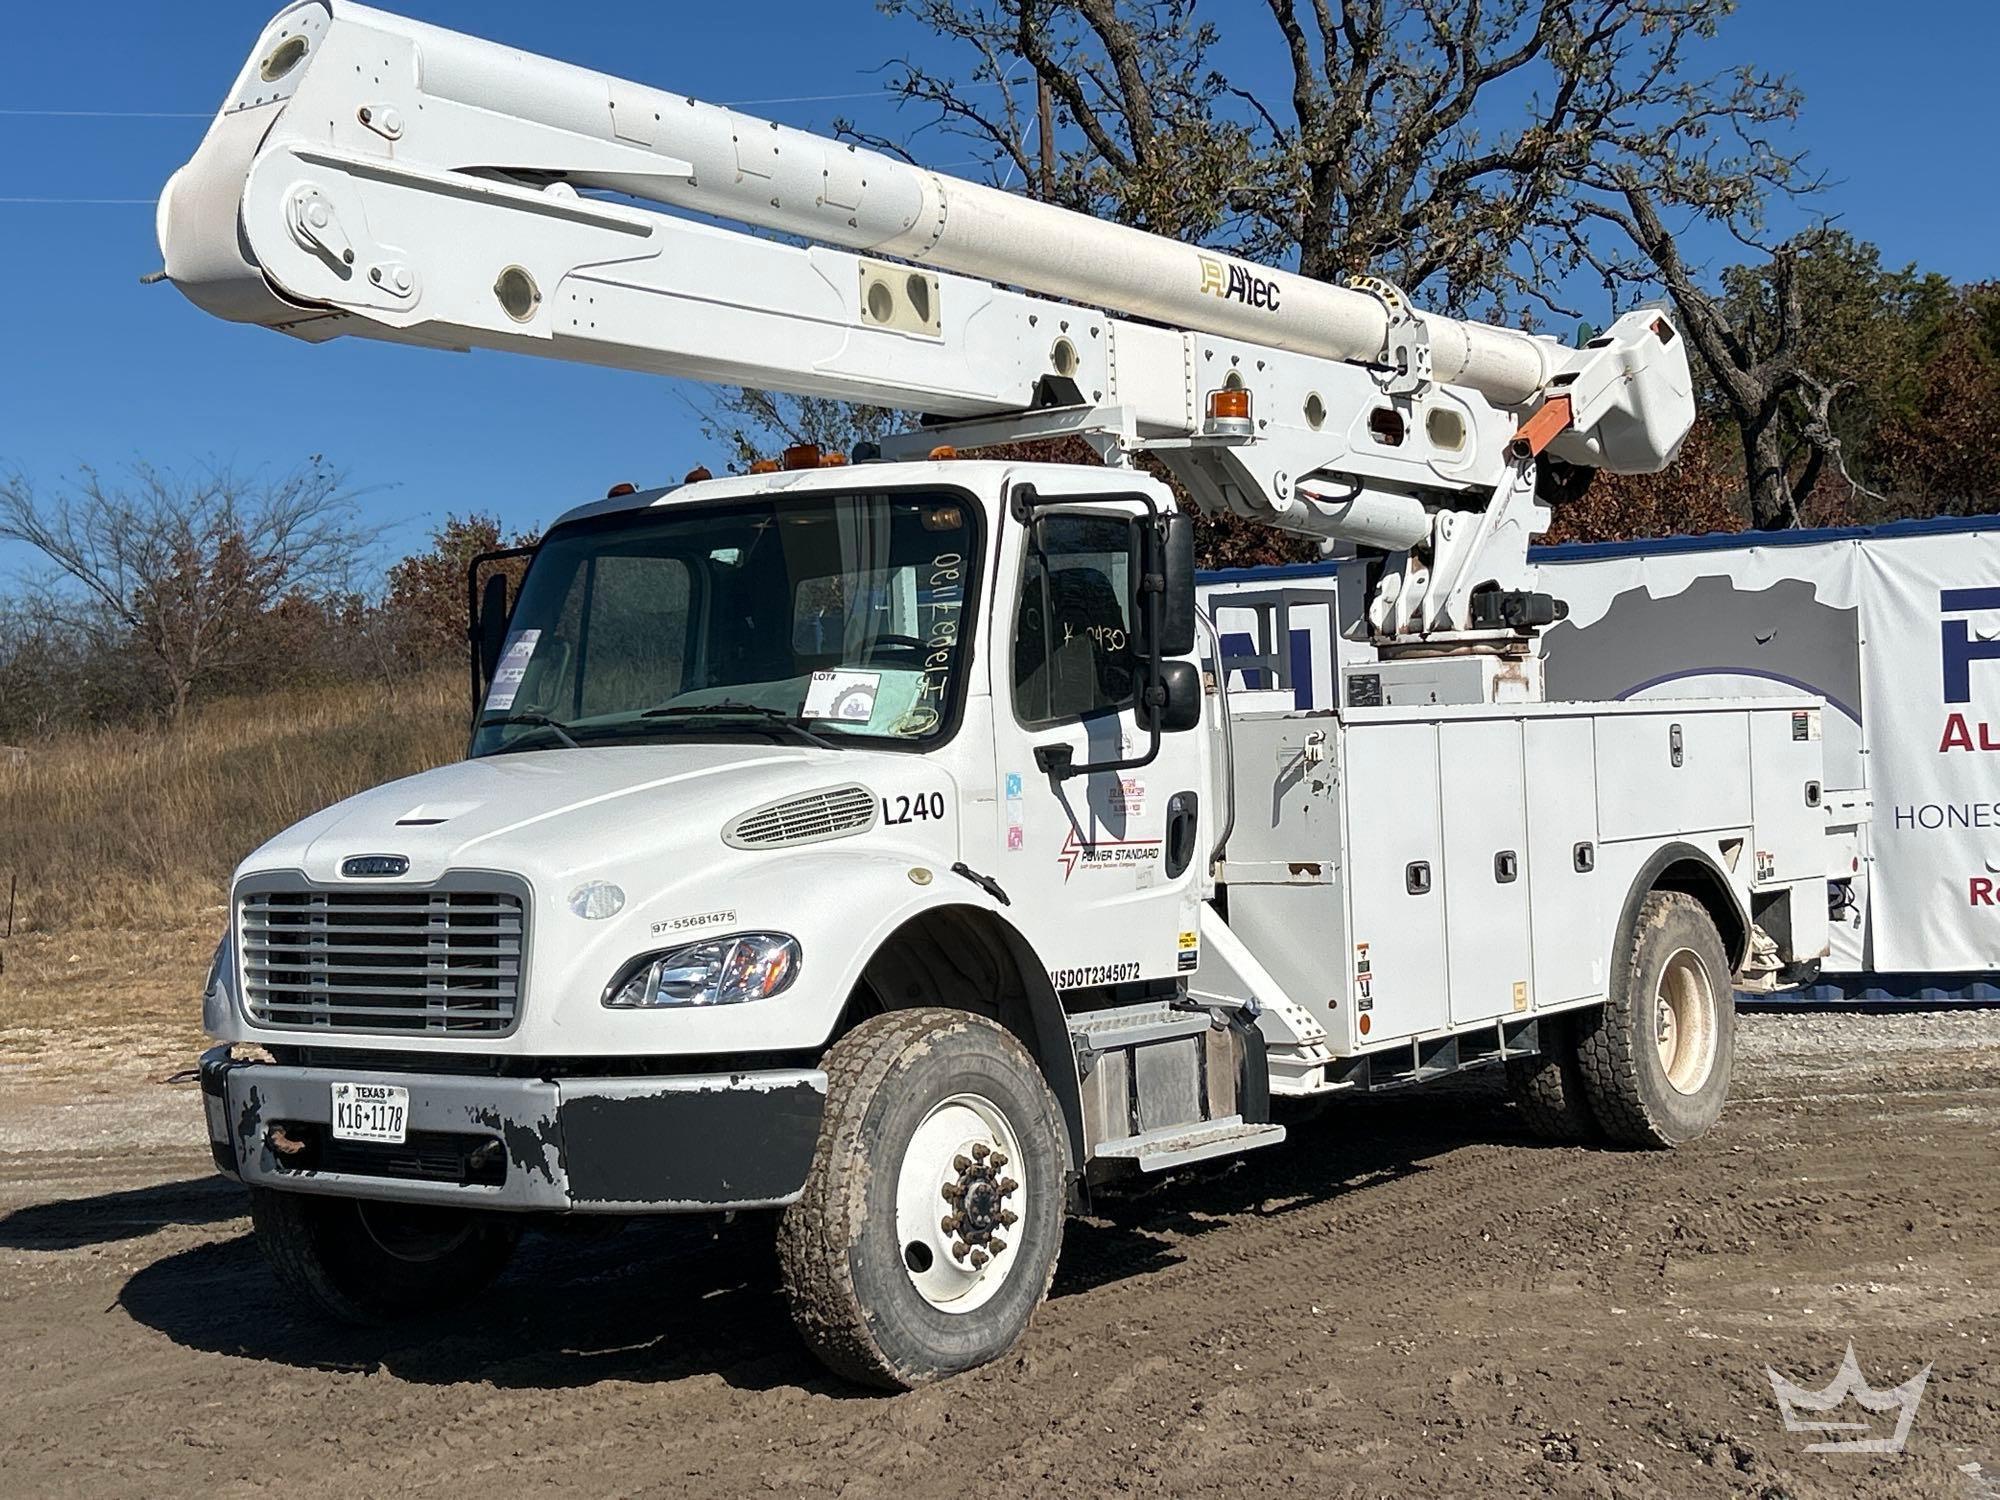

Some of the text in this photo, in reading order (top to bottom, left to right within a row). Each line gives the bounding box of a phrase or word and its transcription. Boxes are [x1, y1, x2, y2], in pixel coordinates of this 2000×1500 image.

[1225, 263, 1280, 312] Altec
[813, 673, 837, 681] LOT#
[881, 791, 945, 826] L240
[1081, 848, 1160, 862] POWER STANDARD
[652, 911, 736, 933] 97-55681475
[356, 1086, 386, 1099] TEXAS
